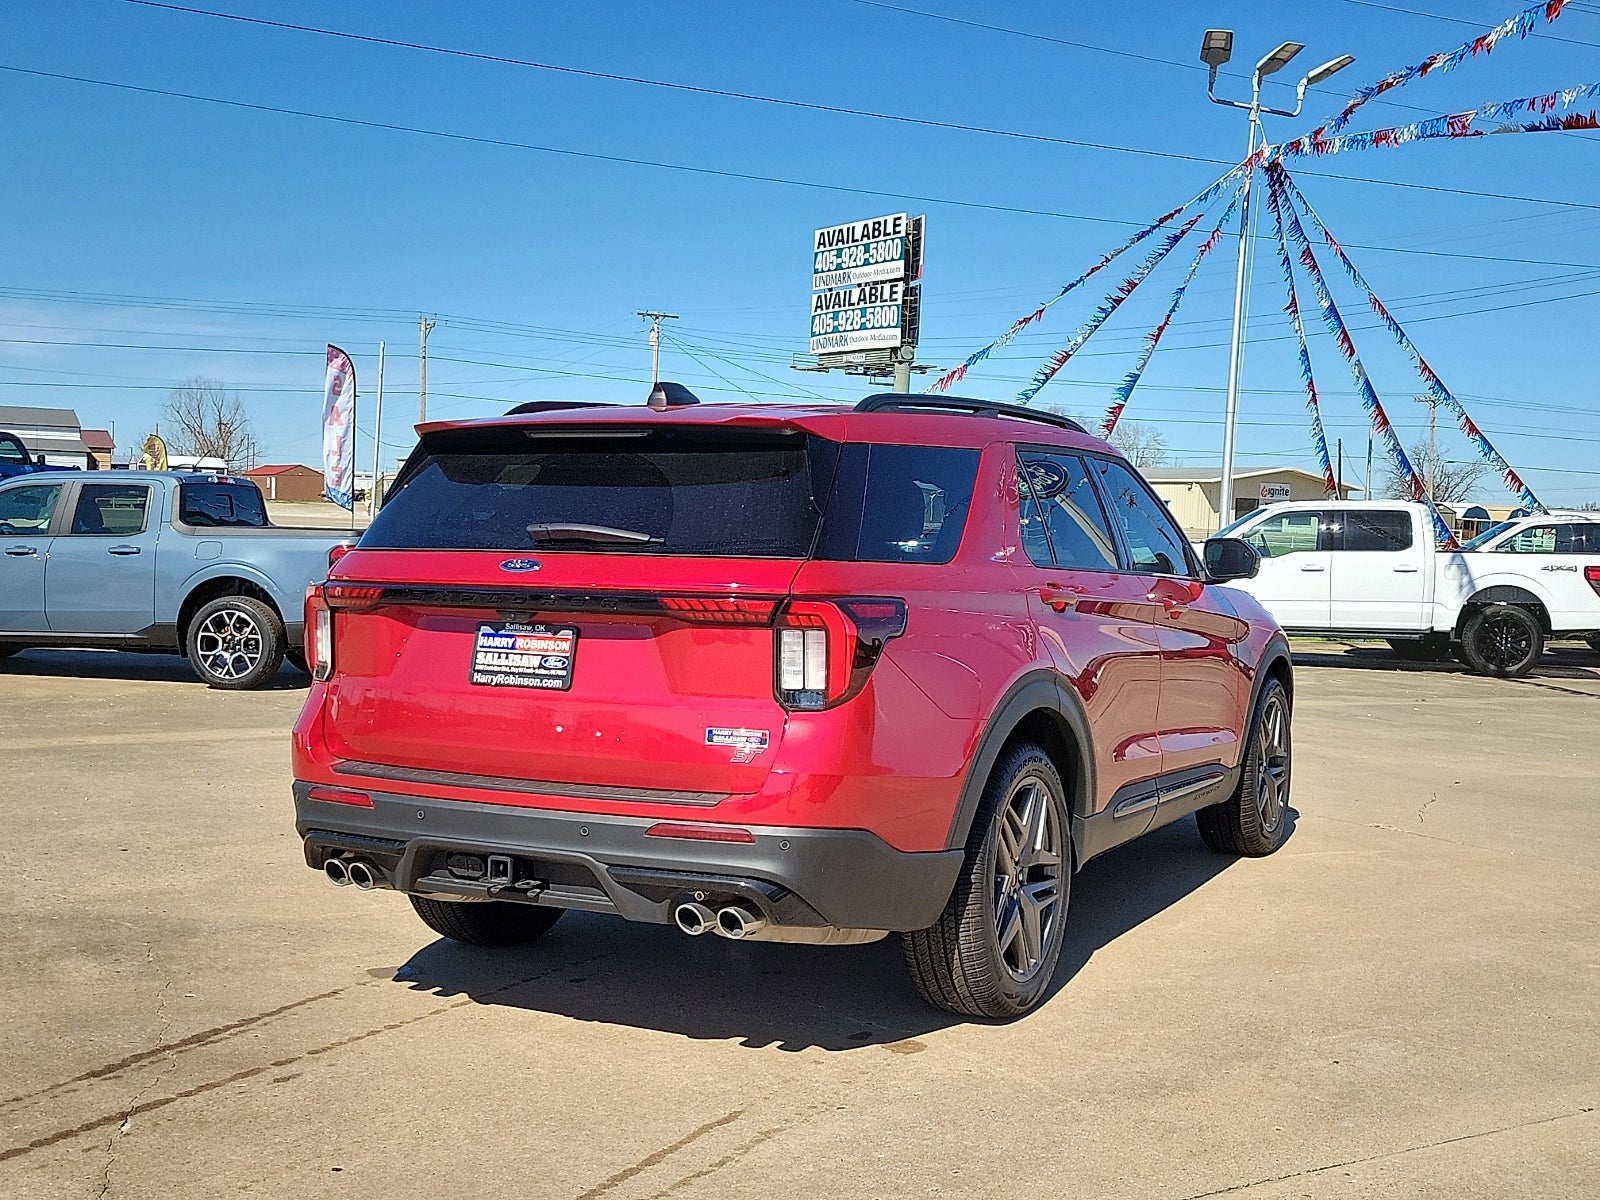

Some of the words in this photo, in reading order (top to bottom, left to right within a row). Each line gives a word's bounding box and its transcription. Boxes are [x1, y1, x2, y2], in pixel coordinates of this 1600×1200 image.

[817, 216, 902, 250] AVAILABLE
[814, 238, 902, 272] 405-928-5800
[814, 271, 852, 288] LINDMARK
[814, 284, 899, 313] AVAILABLE
[812, 305, 898, 335] 405-928-5800
[811, 334, 849, 351] LINDMARK
[410, 589, 619, 609] EXPLORER
[505, 623, 534, 632] Sallisaw,
[535, 624, 546, 632] OK
[479, 635, 516, 648] HARRY
[516, 637, 571, 651] ROBINSON
[475, 651, 542, 667] SALLISAW
[473, 672, 563, 688] HarryRobinson.com
